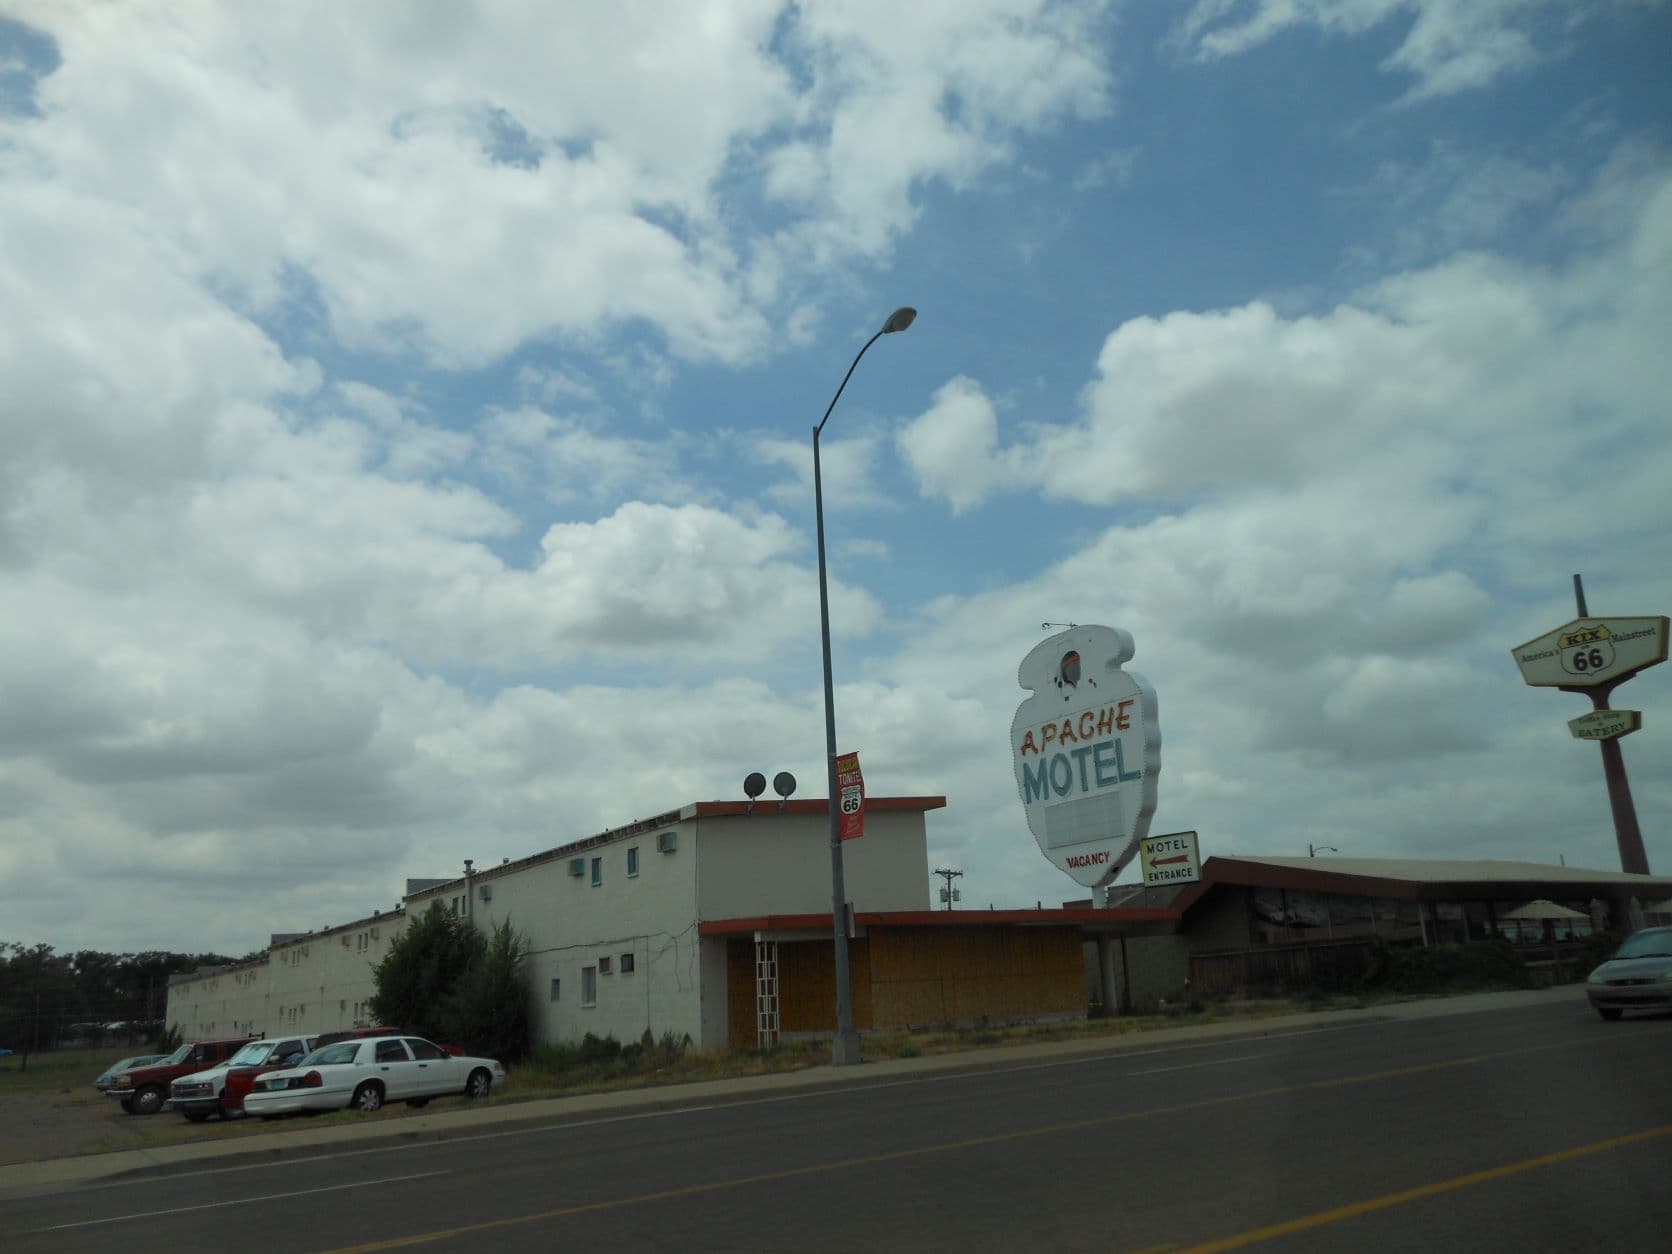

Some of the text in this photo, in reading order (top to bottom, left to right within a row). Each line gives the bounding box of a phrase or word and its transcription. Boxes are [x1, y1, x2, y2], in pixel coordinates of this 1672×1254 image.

[1566, 629, 1601, 646] KIX
[1573, 648, 1603, 671] 66
[1020, 700, 1135, 756] APACHE
[1578, 723, 1625, 737] EATERY
[1023, 738, 1141, 804] MOTEL
[843, 798, 859, 812] 66
[1146, 839, 1189, 855] MOTEL
[1066, 851, 1110, 869] VACANCY
[1148, 867, 1193, 882] ENTRANCE
